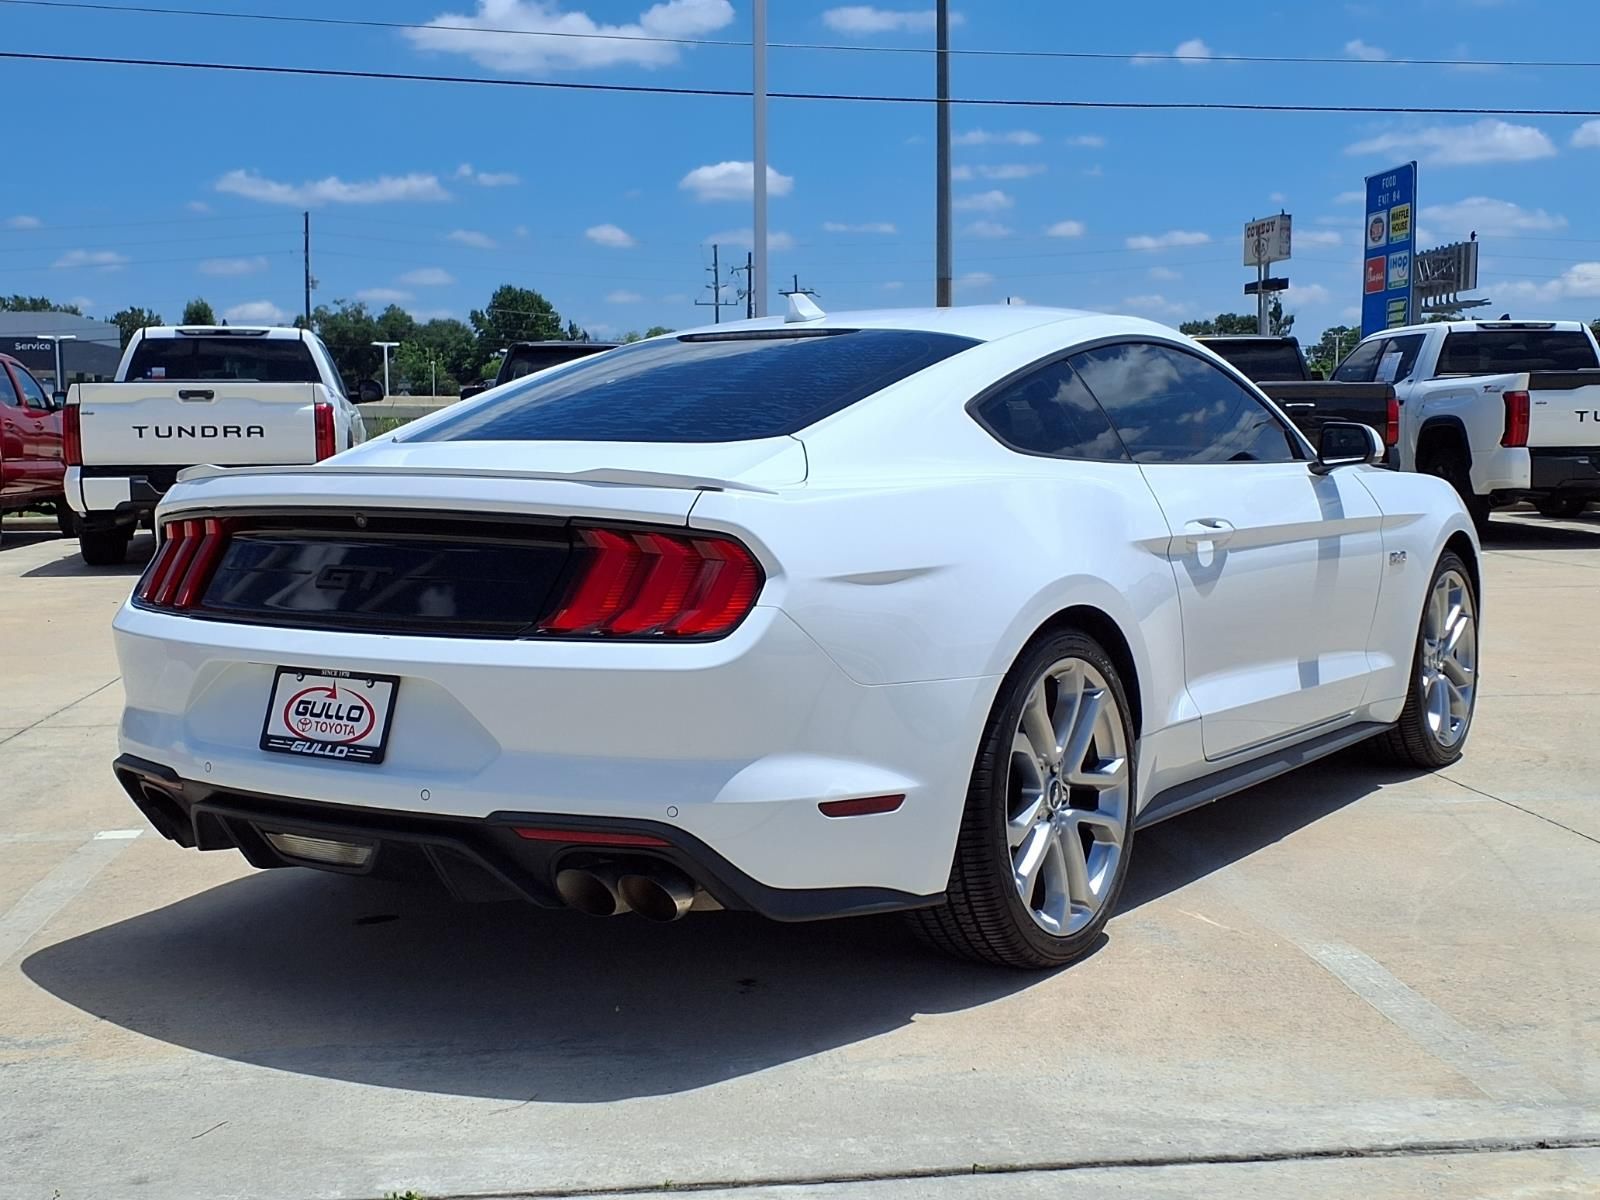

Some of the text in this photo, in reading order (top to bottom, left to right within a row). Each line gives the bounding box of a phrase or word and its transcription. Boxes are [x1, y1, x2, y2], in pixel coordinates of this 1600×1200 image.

[1382, 175, 1397, 189] FOOD
[1391, 208, 1409, 222] WAFFLE
[1246, 219, 1276, 239] COWBOY
[1391, 220, 1408, 233] HOUSE
[14, 341, 51, 351] Service
[132, 425, 265, 439] TUNDRA
[294, 699, 365, 723] GULLO
[313, 720, 356, 737] TOYOTA
[290, 740, 349, 758] GULLO
